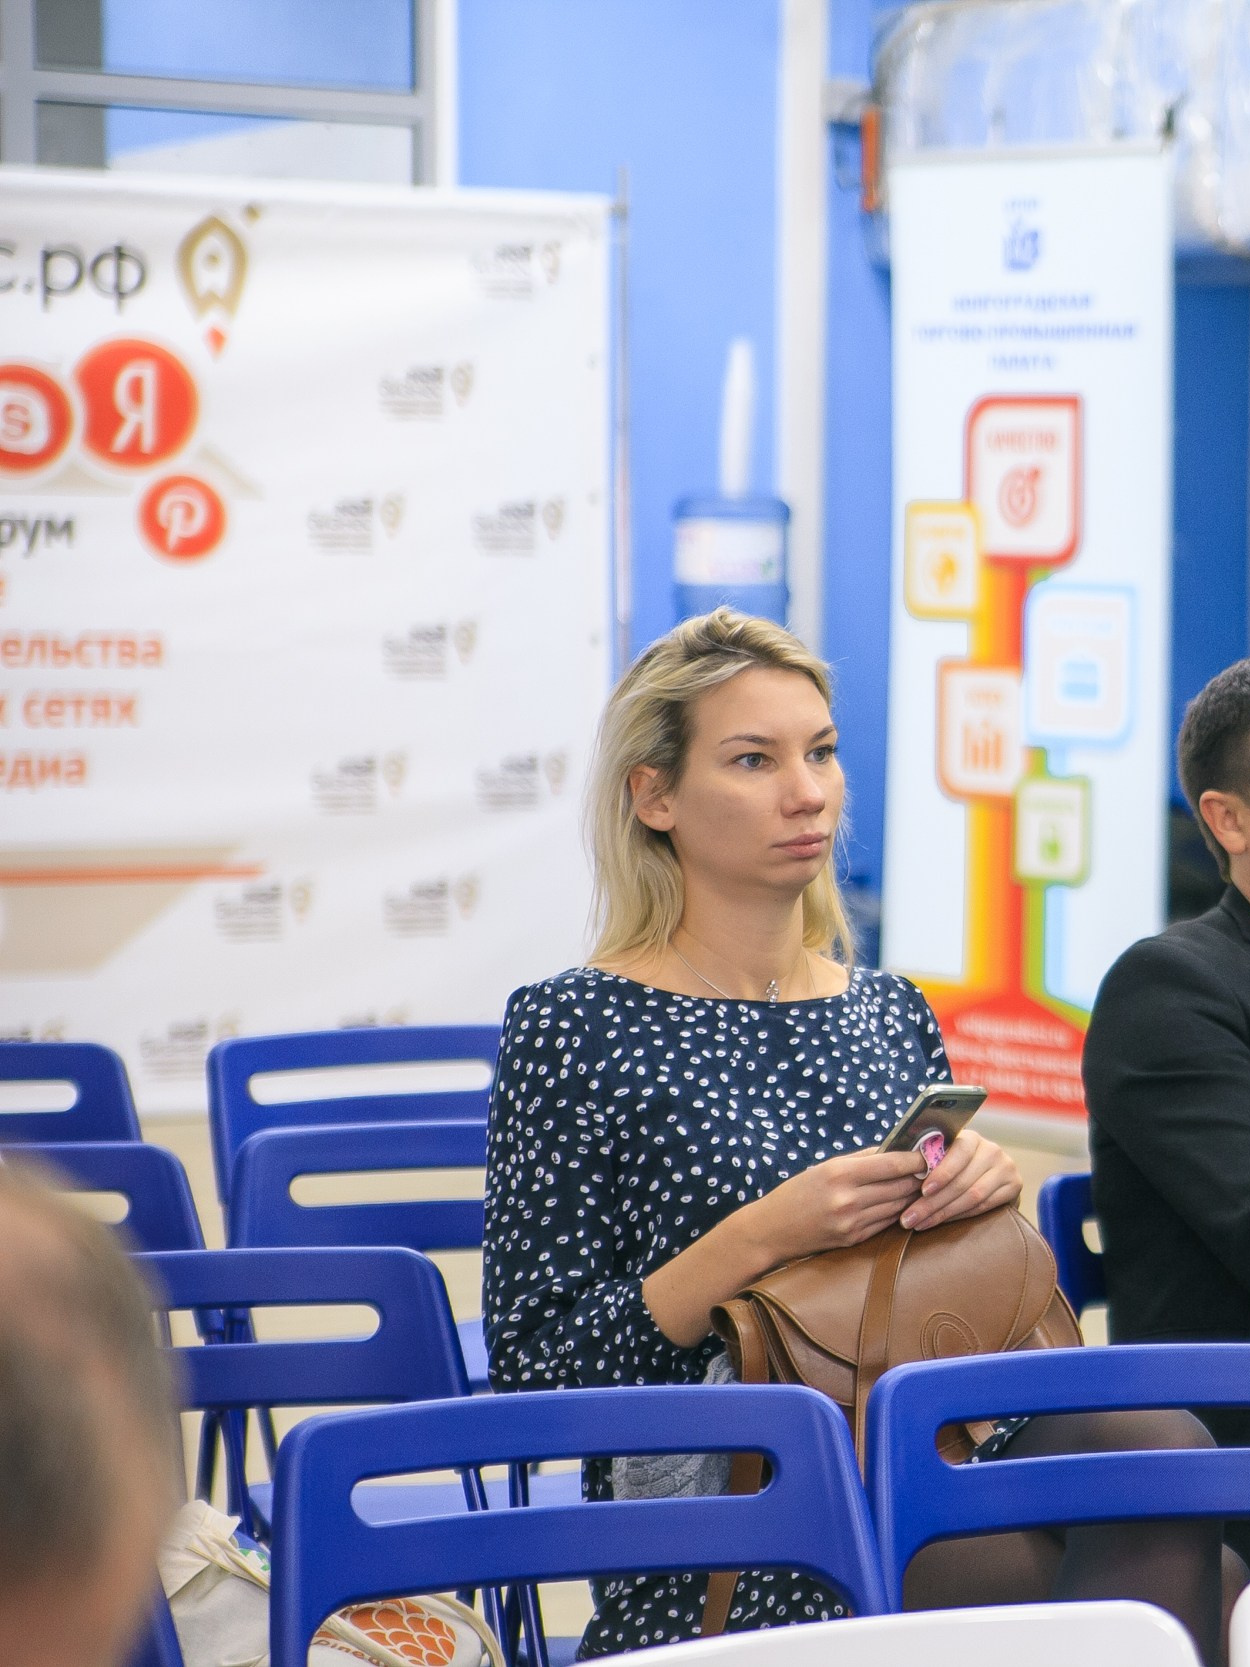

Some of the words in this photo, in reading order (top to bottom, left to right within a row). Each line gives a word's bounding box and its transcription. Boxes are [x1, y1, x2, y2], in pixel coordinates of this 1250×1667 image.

[111, 361, 157, 454] Я
[1, 631, 165, 670] ельства
[22, 687, 140, 729] сетях
[0, 752, 87, 793] диа
